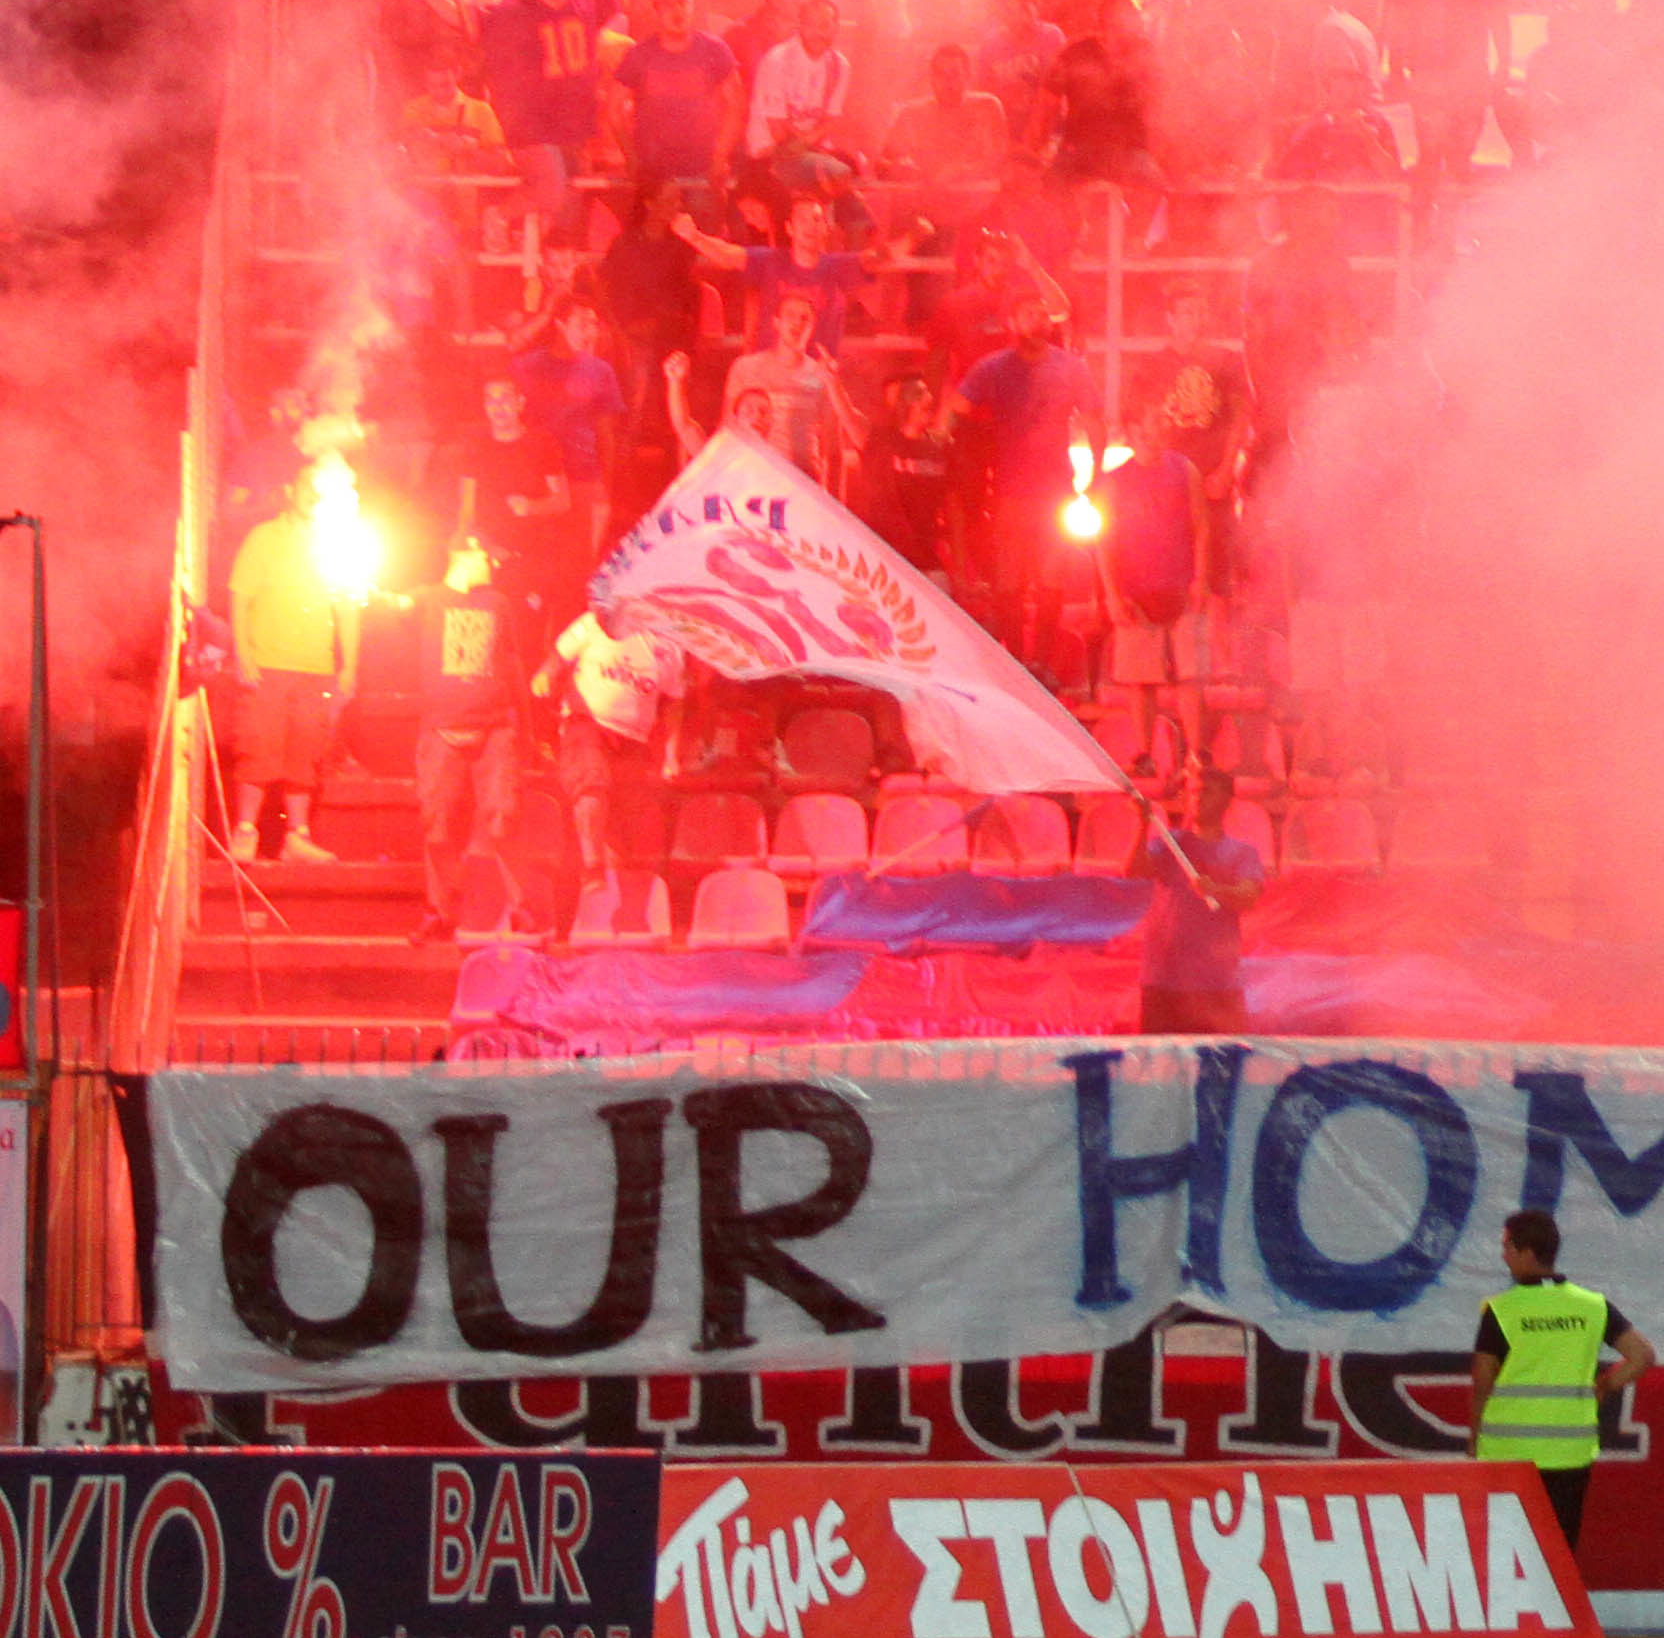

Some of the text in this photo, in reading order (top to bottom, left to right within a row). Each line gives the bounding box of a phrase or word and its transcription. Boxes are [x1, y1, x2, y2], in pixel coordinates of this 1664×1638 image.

[221, 1078, 887, 1359] OUR
[1520, 1315, 1587, 1333] SECURITY
[0, 1472, 225, 1638] KIO
[428, 1462, 592, 1603] BAR
[655, 1470, 1576, 1638] Πάμε ΣΤΟΙΧΗΜΑ
